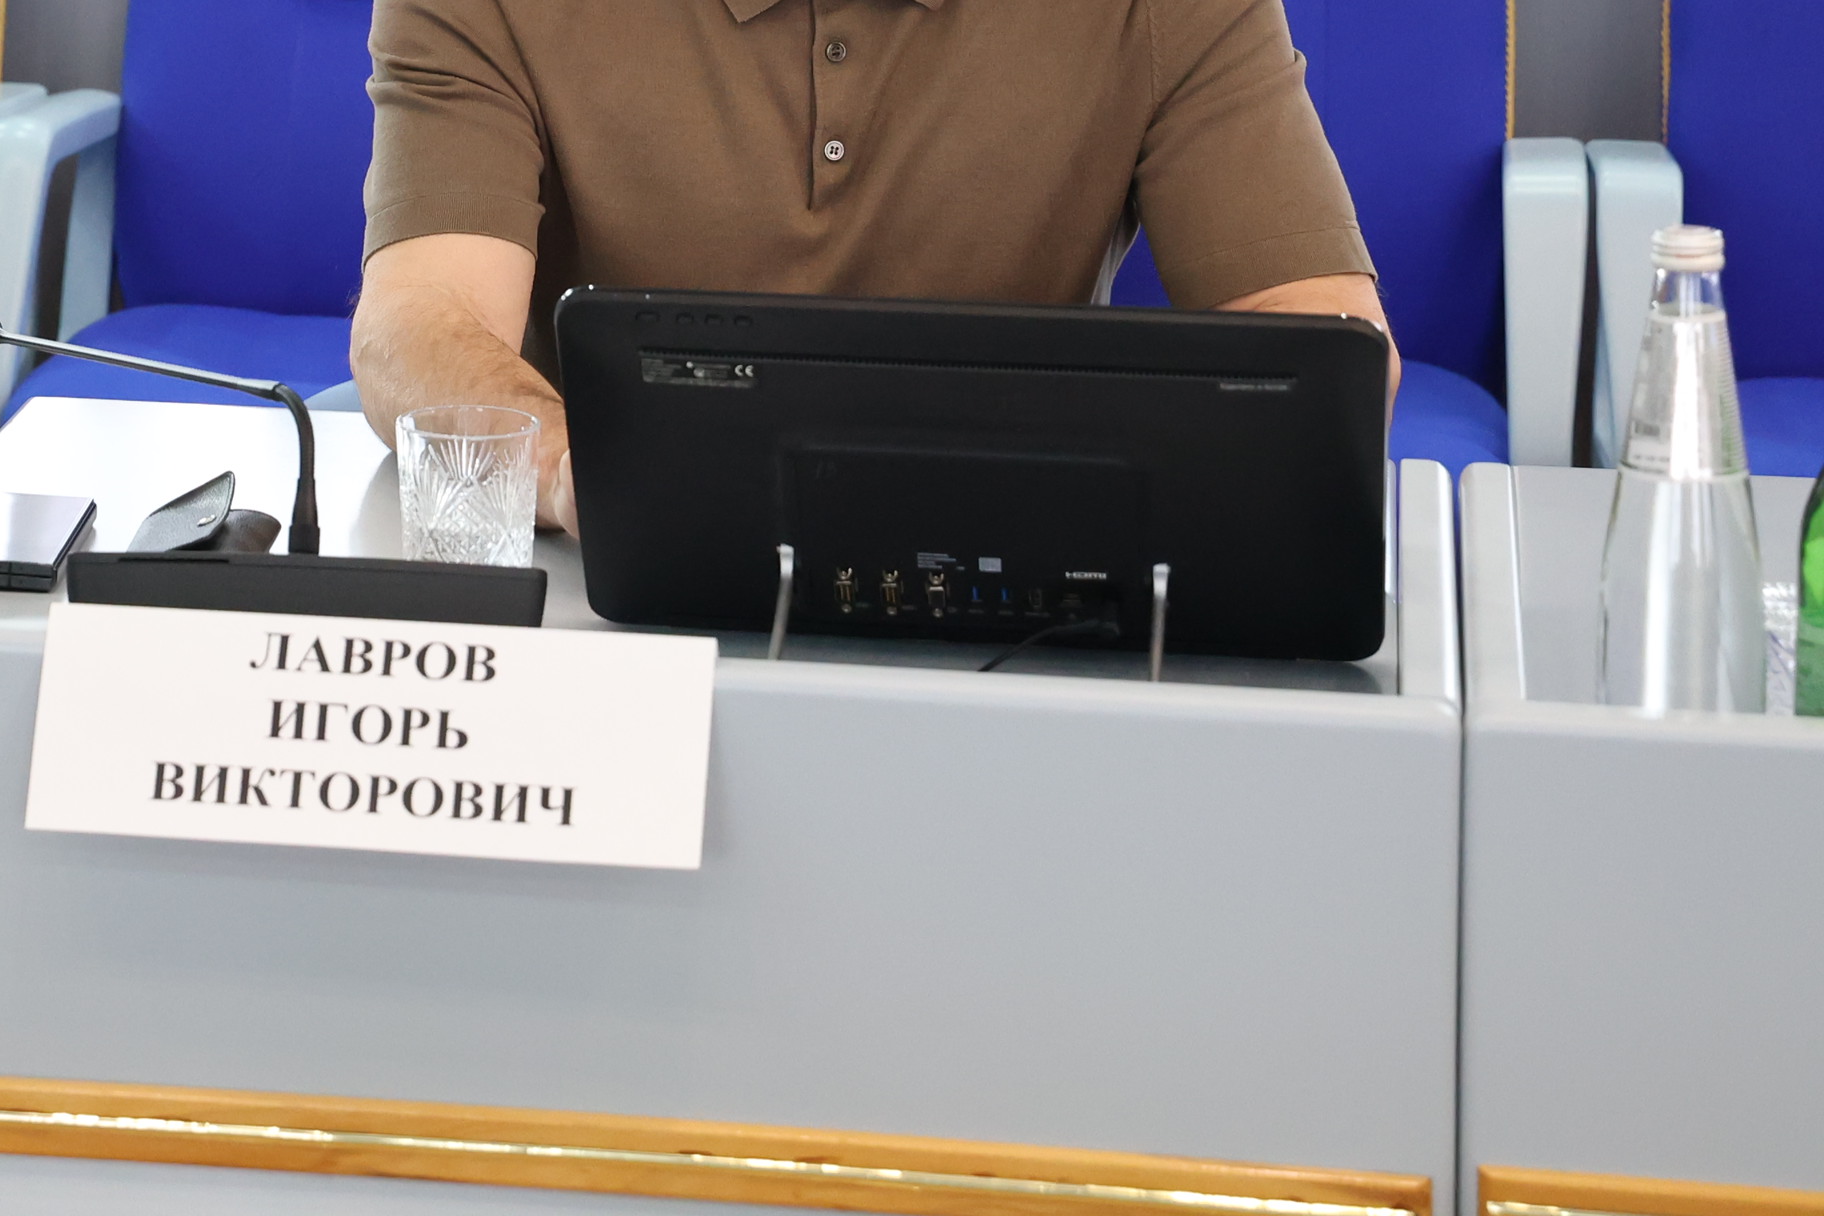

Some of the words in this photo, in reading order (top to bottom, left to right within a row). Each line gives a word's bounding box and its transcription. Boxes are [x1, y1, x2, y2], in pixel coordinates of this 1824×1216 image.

[248, 631, 498, 684] ЛАВРОВ
[267, 698, 470, 751] ИГОРЬ
[148, 760, 578, 827] ВИКТОРОВИЧ
